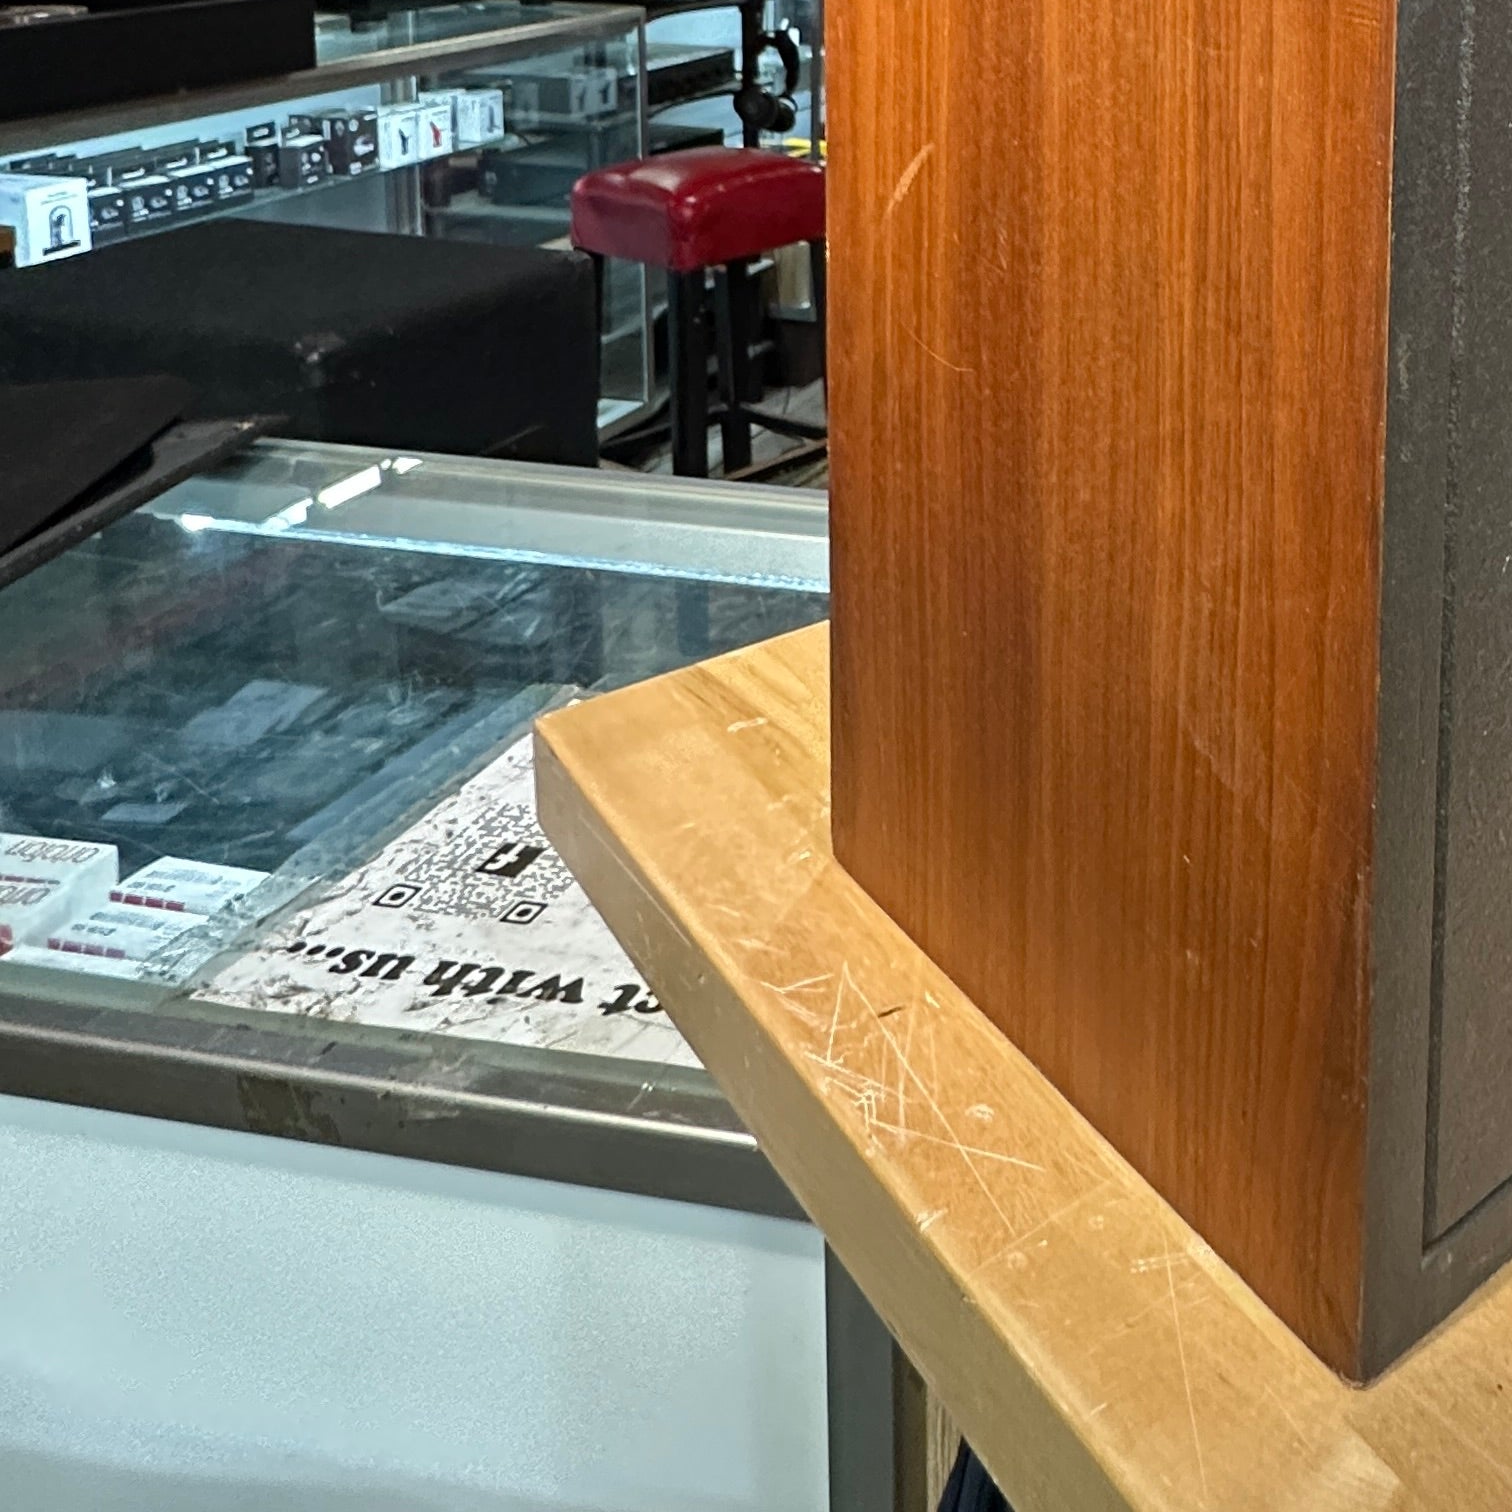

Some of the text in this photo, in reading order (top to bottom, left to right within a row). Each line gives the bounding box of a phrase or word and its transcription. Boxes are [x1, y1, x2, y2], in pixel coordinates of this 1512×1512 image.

[4, 840, 100, 864] ortofon
[286, 941, 415, 981] us...
[424, 959, 585, 1005] with
